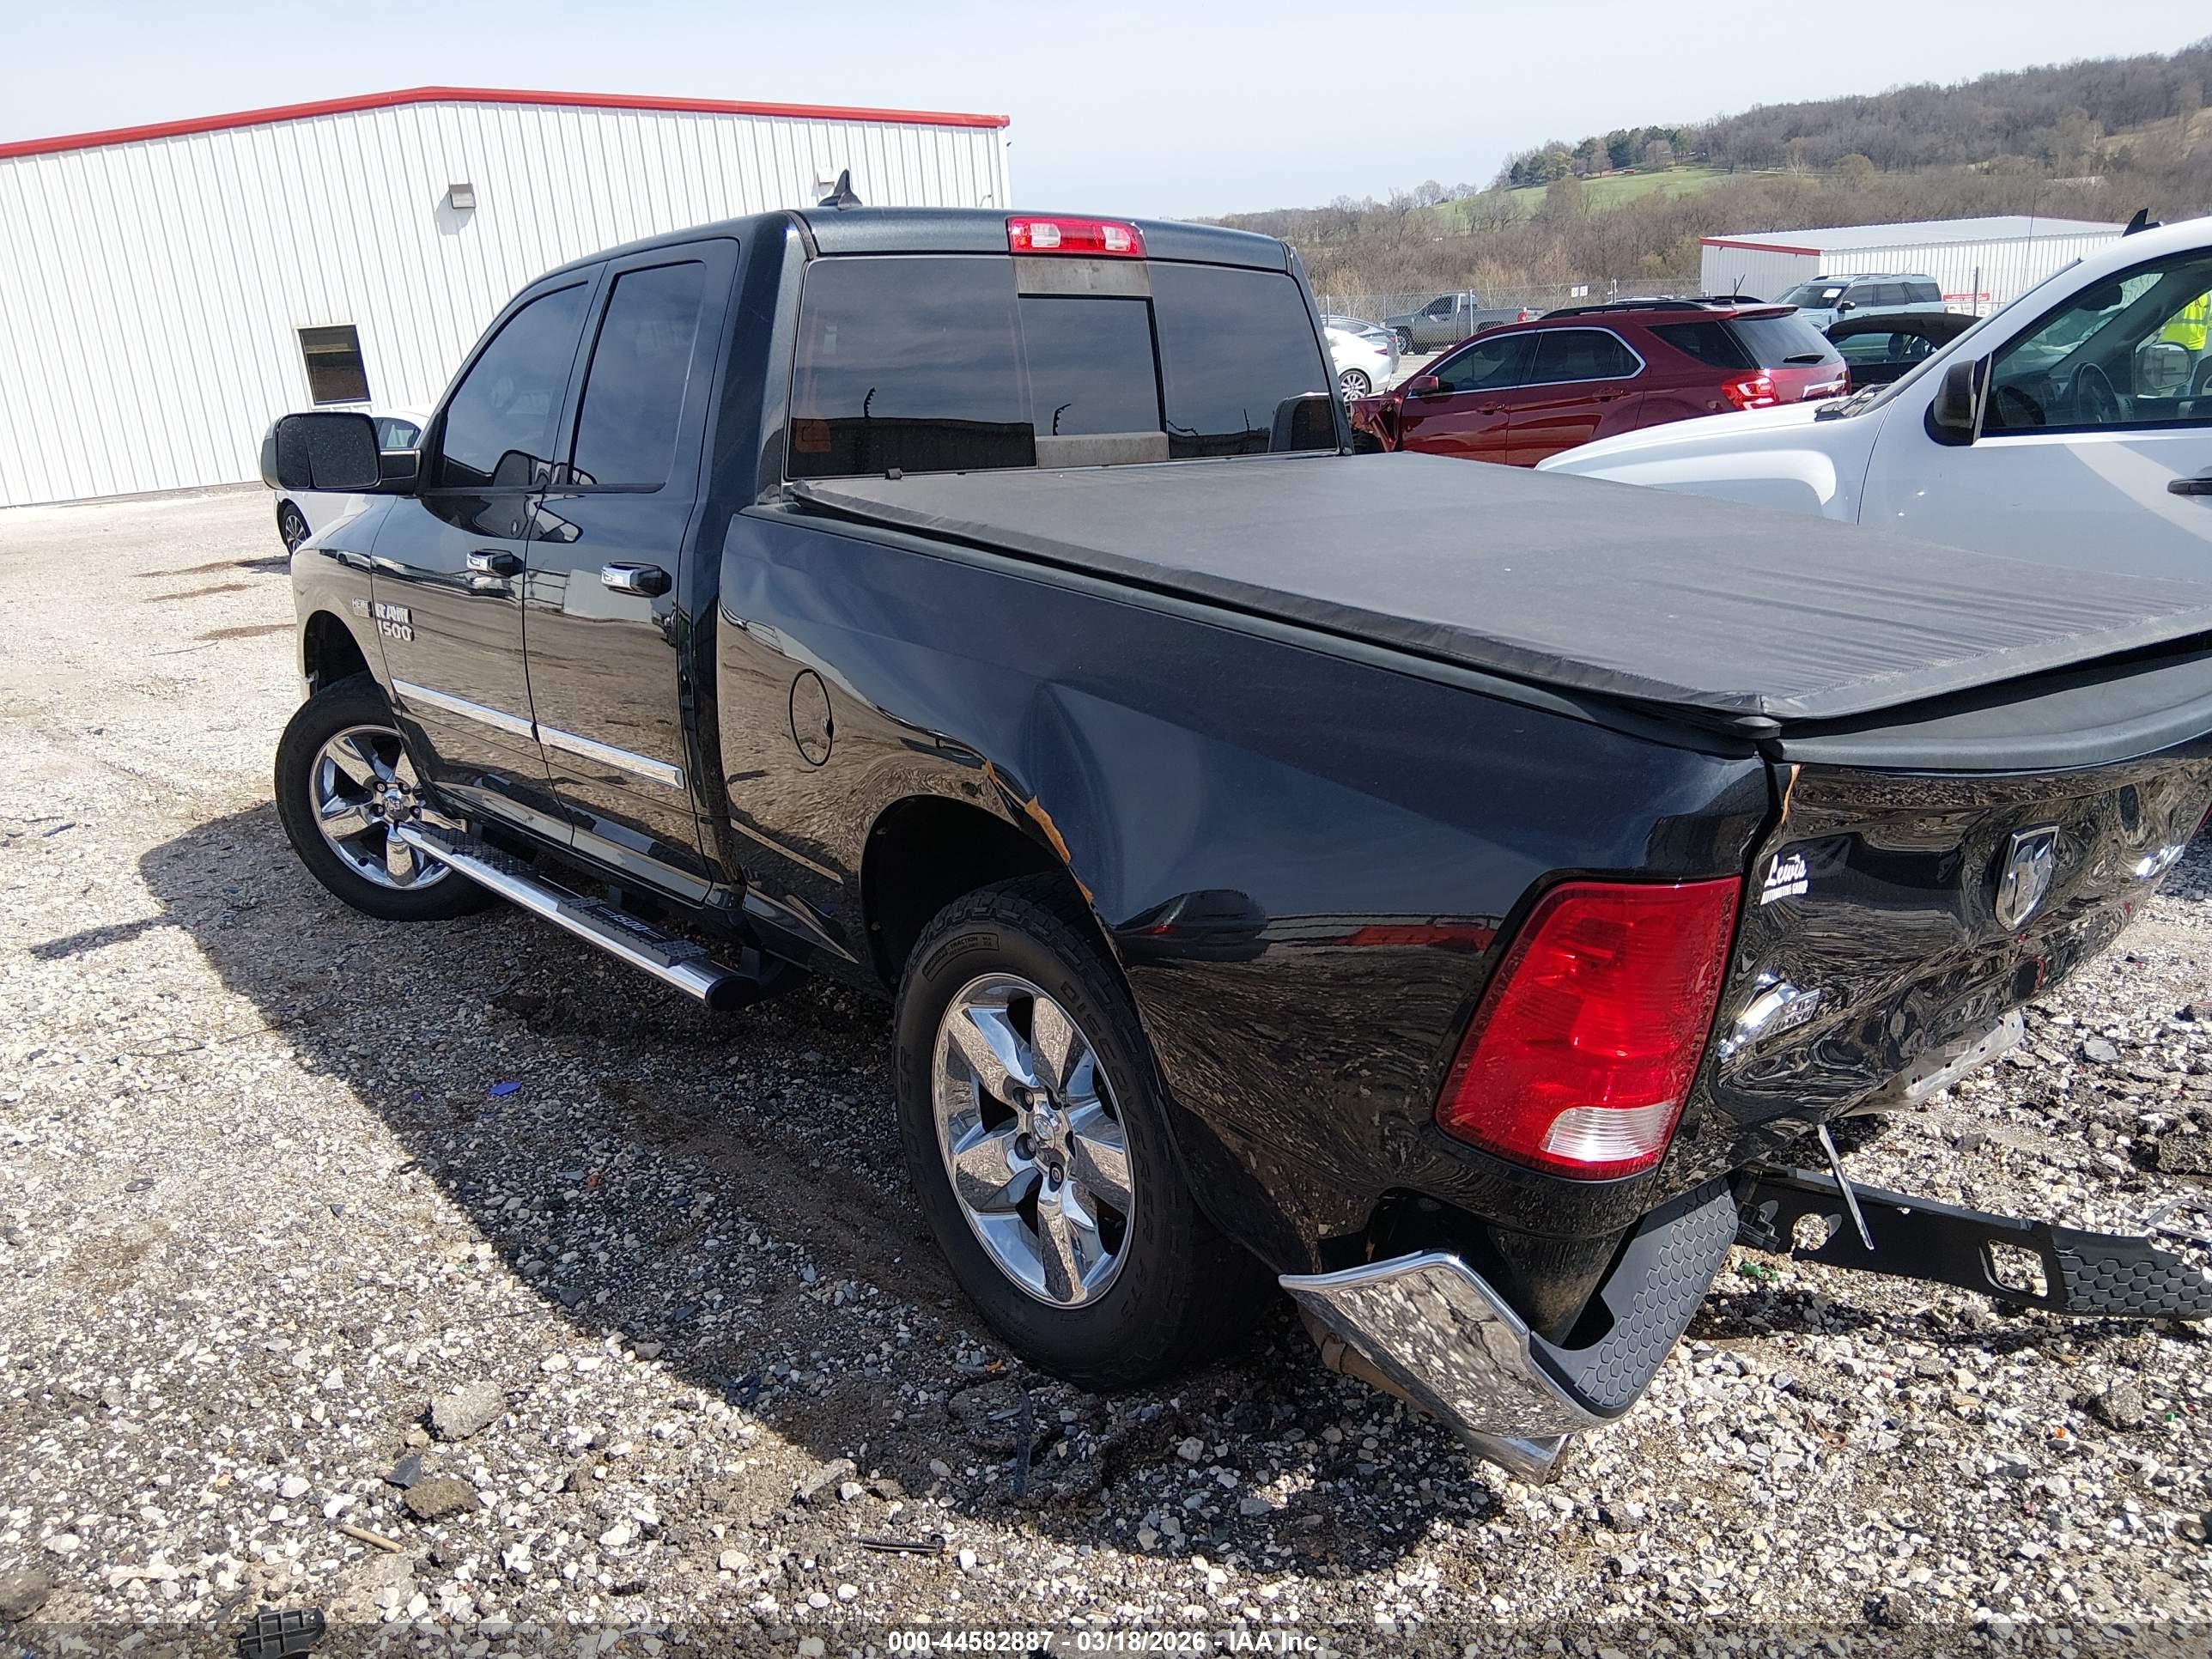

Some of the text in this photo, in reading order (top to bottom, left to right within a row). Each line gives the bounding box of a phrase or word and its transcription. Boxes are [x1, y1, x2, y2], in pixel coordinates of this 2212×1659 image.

[375, 603, 410, 624] RAM
[377, 619, 412, 642] 1500
[1764, 854, 1807, 888] Lewis
[1060, 981, 1154, 1245] DISCOVERER
